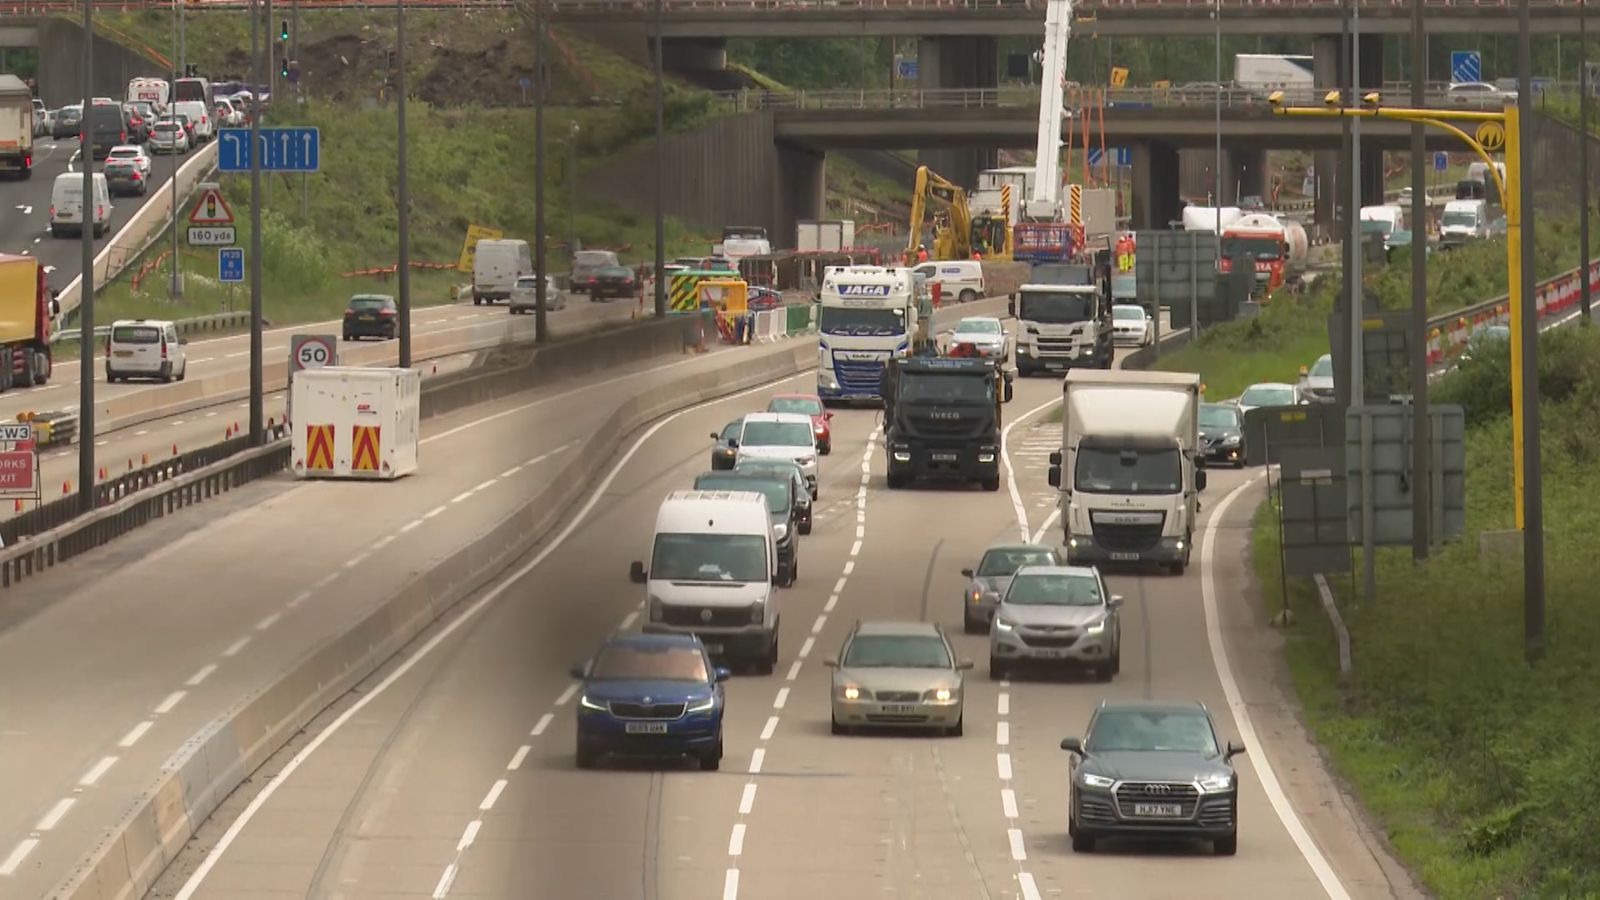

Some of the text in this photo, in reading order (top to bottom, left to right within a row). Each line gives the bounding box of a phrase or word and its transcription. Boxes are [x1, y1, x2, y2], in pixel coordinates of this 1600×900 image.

[192, 231, 232, 242] 160 yds
[843, 285, 886, 296] JAGA
[301, 349, 327, 363] 50
[930, 411, 960, 420] IVECO
